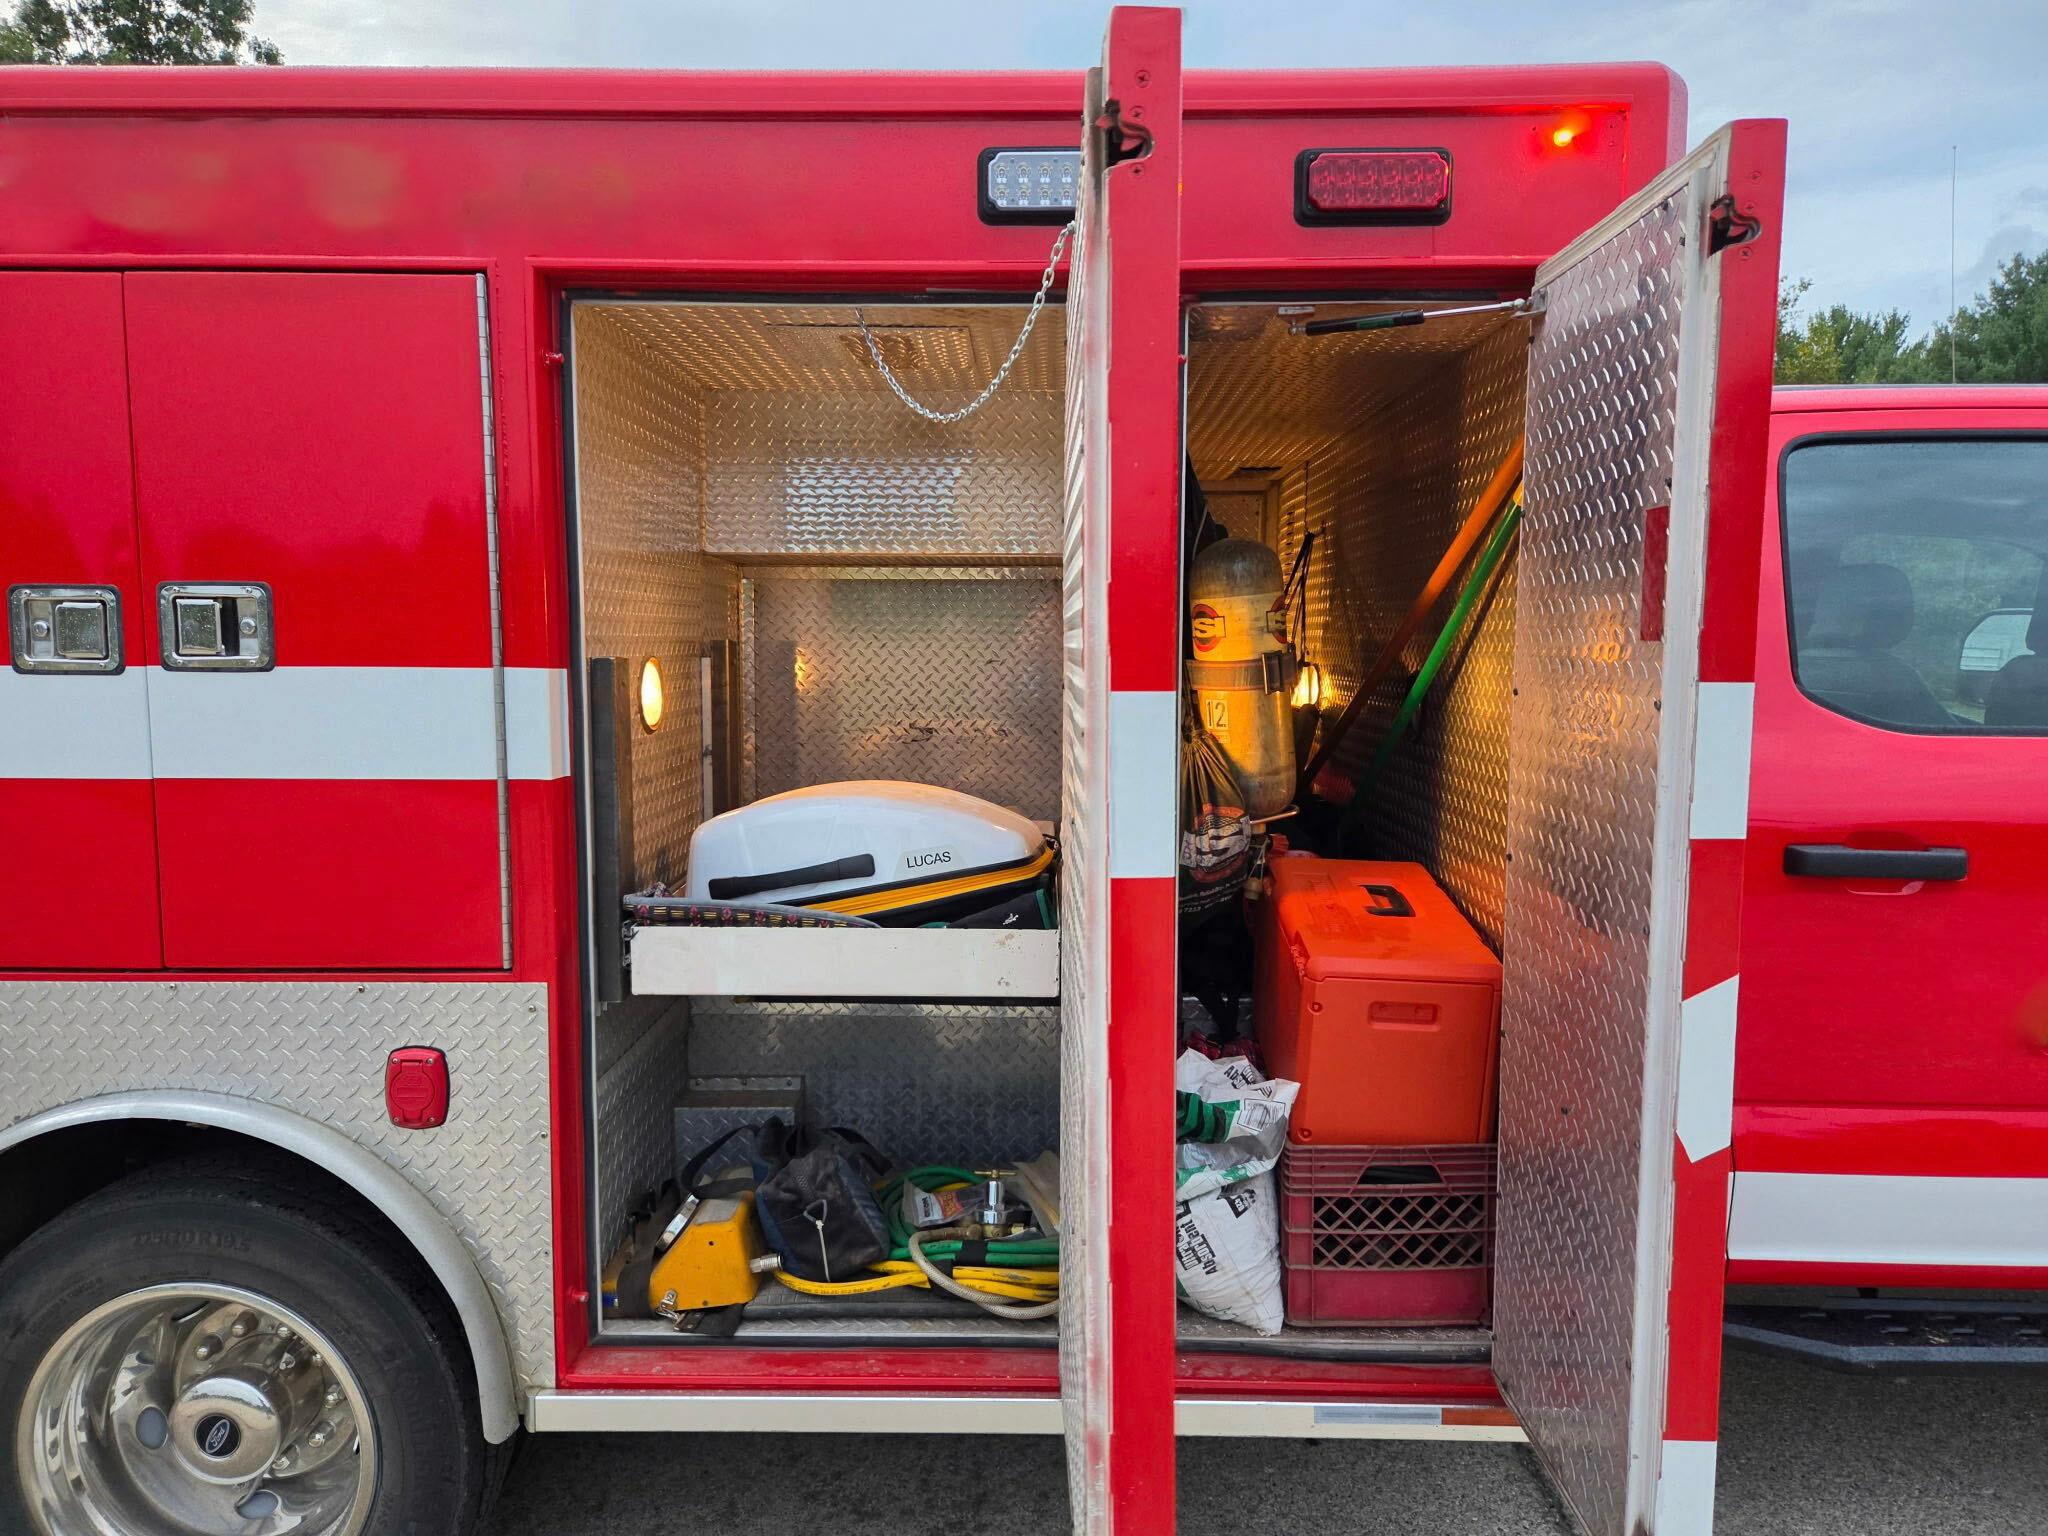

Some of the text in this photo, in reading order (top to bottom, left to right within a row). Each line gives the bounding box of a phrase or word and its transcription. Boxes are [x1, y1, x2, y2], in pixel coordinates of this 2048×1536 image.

[1207, 701, 1227, 728] 12
[906, 851, 952, 868] LUCAS
[1180, 1219, 1219, 1276] Absorbent
[210, 1426, 225, 1447] Ford
